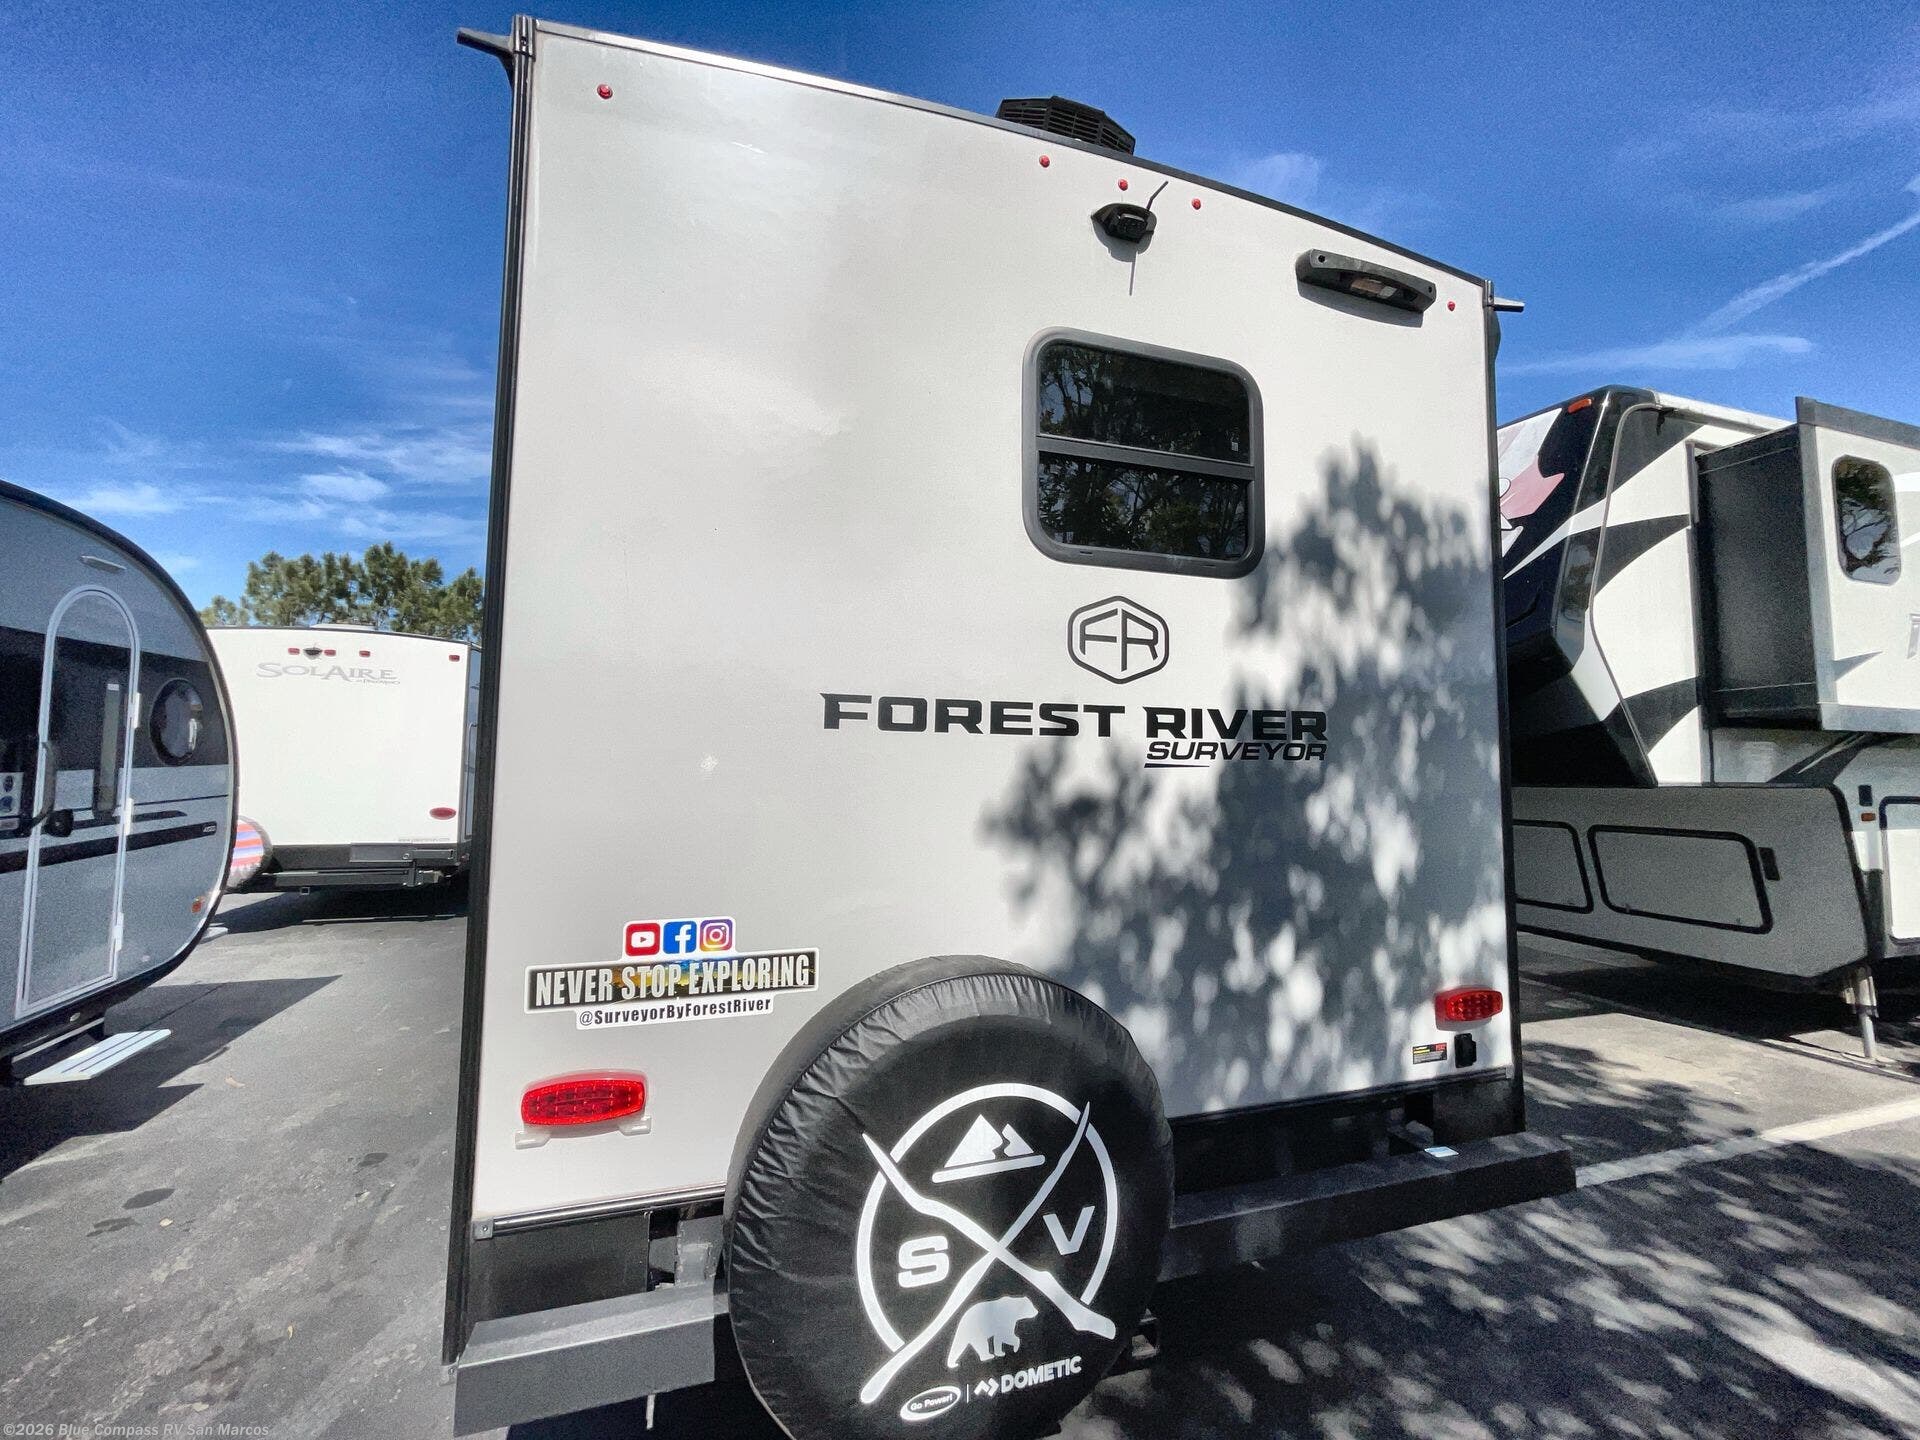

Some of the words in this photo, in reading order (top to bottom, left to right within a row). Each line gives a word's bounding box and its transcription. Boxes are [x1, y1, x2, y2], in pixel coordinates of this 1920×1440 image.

[820, 693, 1125, 738] FOREST
[1142, 706, 1328, 742] RIVER
[1145, 741, 1327, 762] SURVEYOR
[536, 968, 613, 1007] NEVER
[621, 965, 682, 1000] STOP
[689, 954, 810, 996] EXPLORING
[579, 998, 772, 1027] @SurveyorByForestRiver
[897, 1235, 950, 1288] S
[1043, 1205, 1095, 1256] V
[1000, 1355, 1082, 1394] DOMETIC
[910, 1401, 923, 1412] Go
